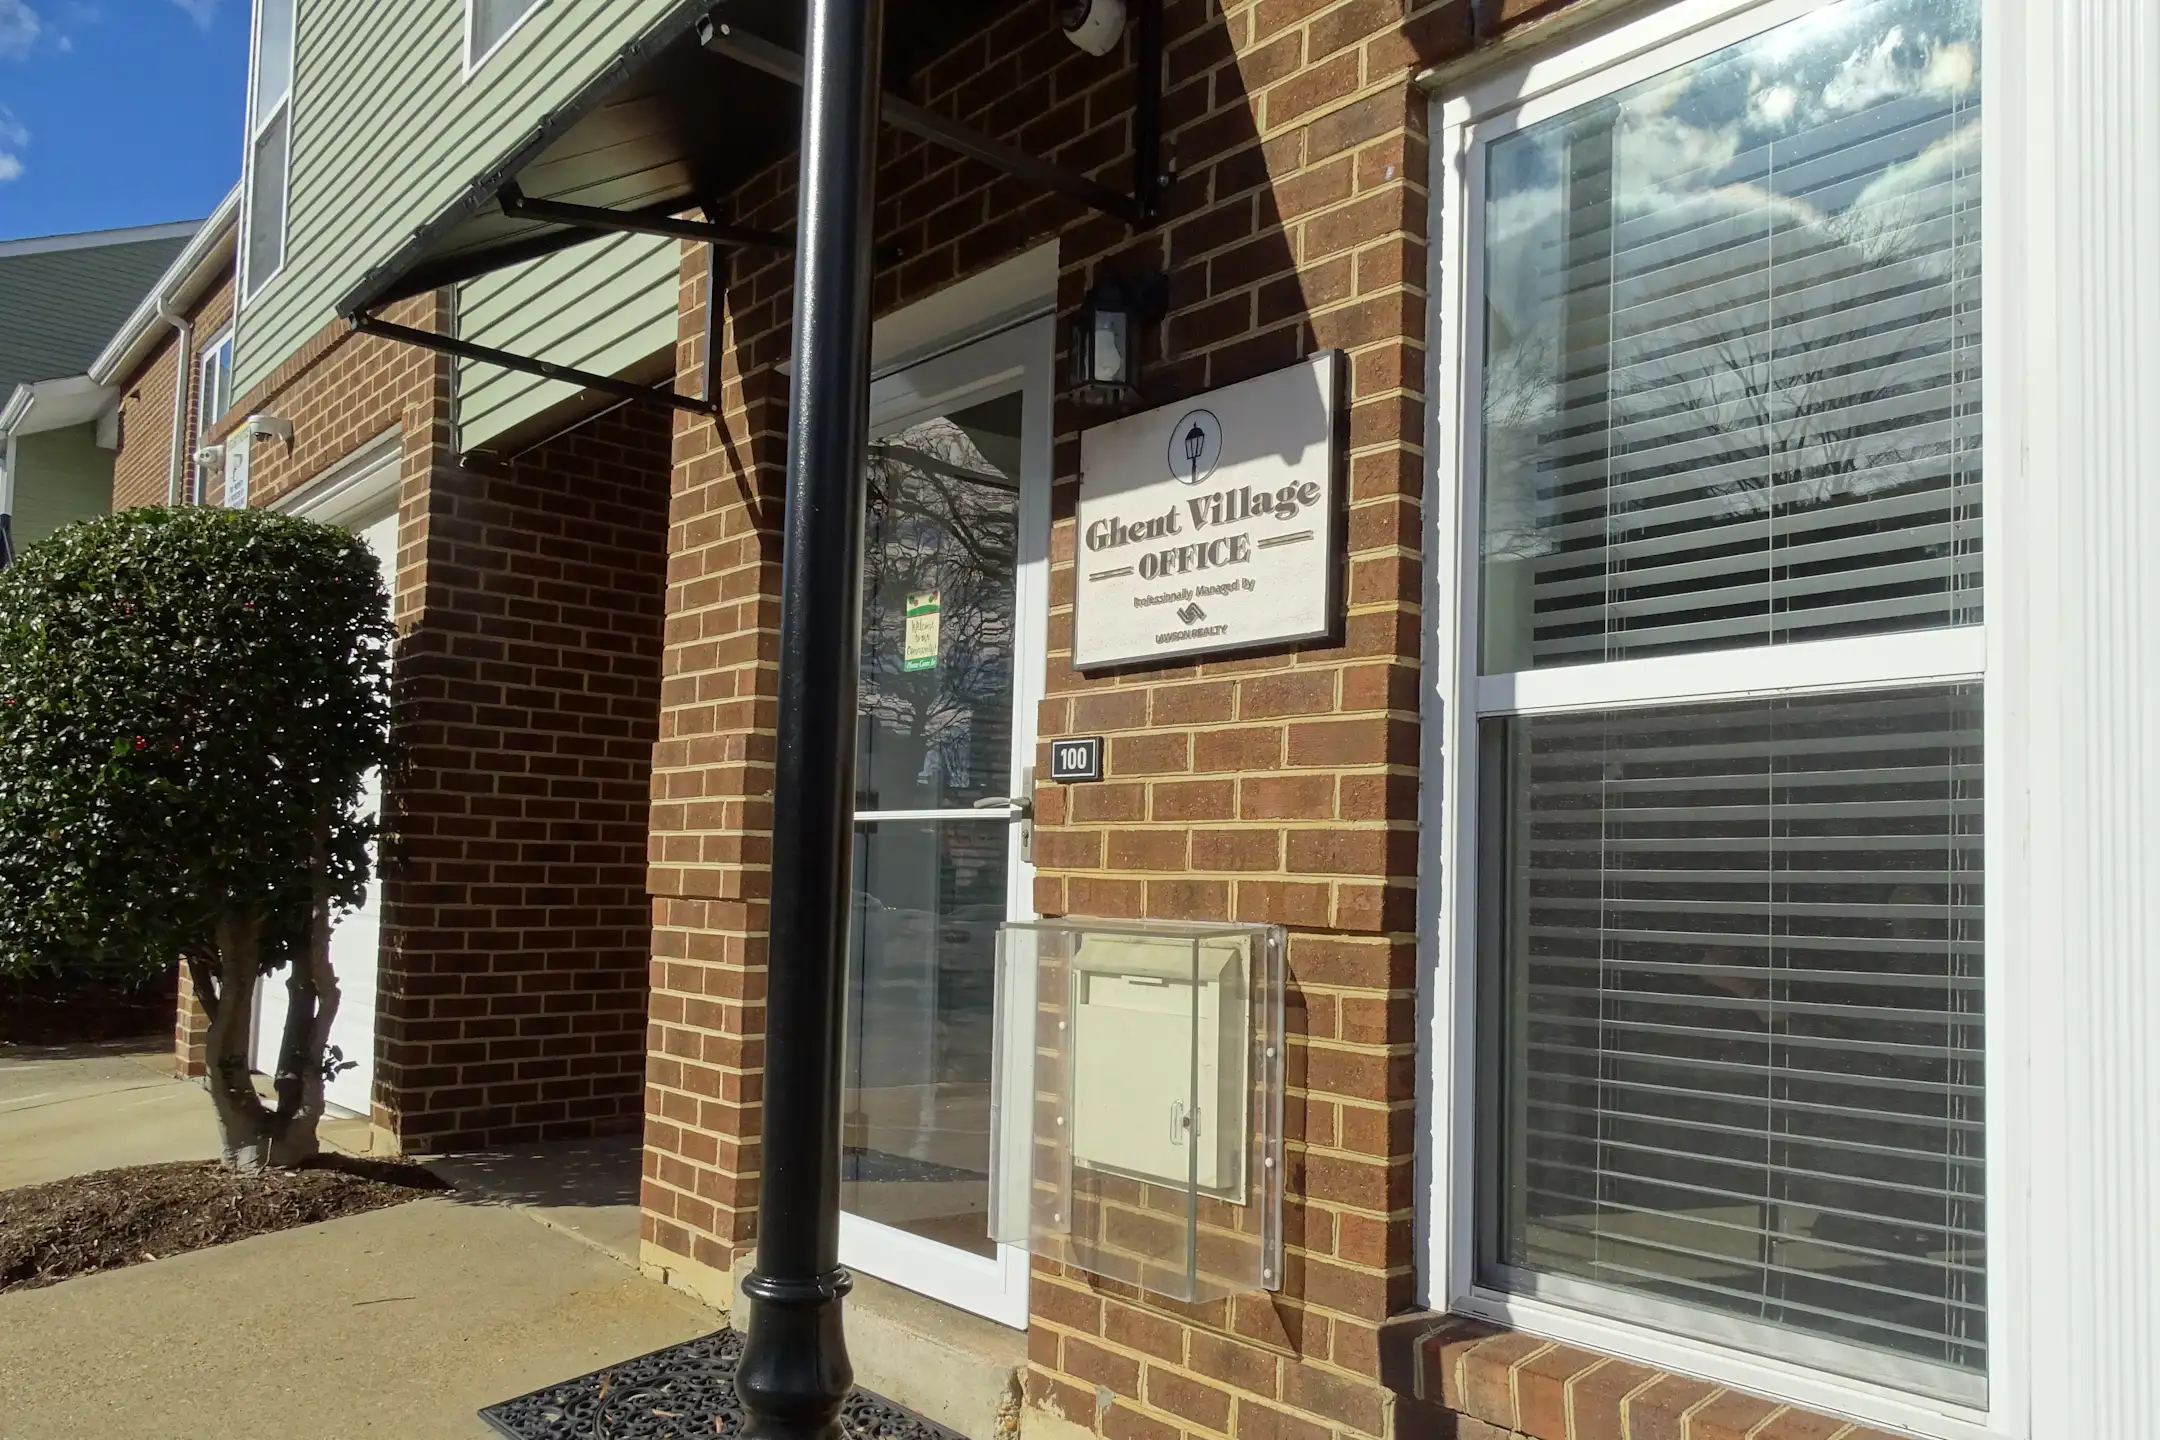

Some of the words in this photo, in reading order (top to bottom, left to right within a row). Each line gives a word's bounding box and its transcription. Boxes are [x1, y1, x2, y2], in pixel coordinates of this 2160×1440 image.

[1085, 505, 1182, 551] Ghent
[1187, 480, 1321, 531] Village
[1139, 532, 1251, 580] OFFICE
[1134, 588, 1193, 608] Professionally
[1195, 579, 1239, 597] Managed
[1241, 577, 1255, 592] By
[1155, 629, 1191, 644] LAWSON
[1191, 624, 1228, 640] REALTY
[1060, 747, 1087, 770] 100
